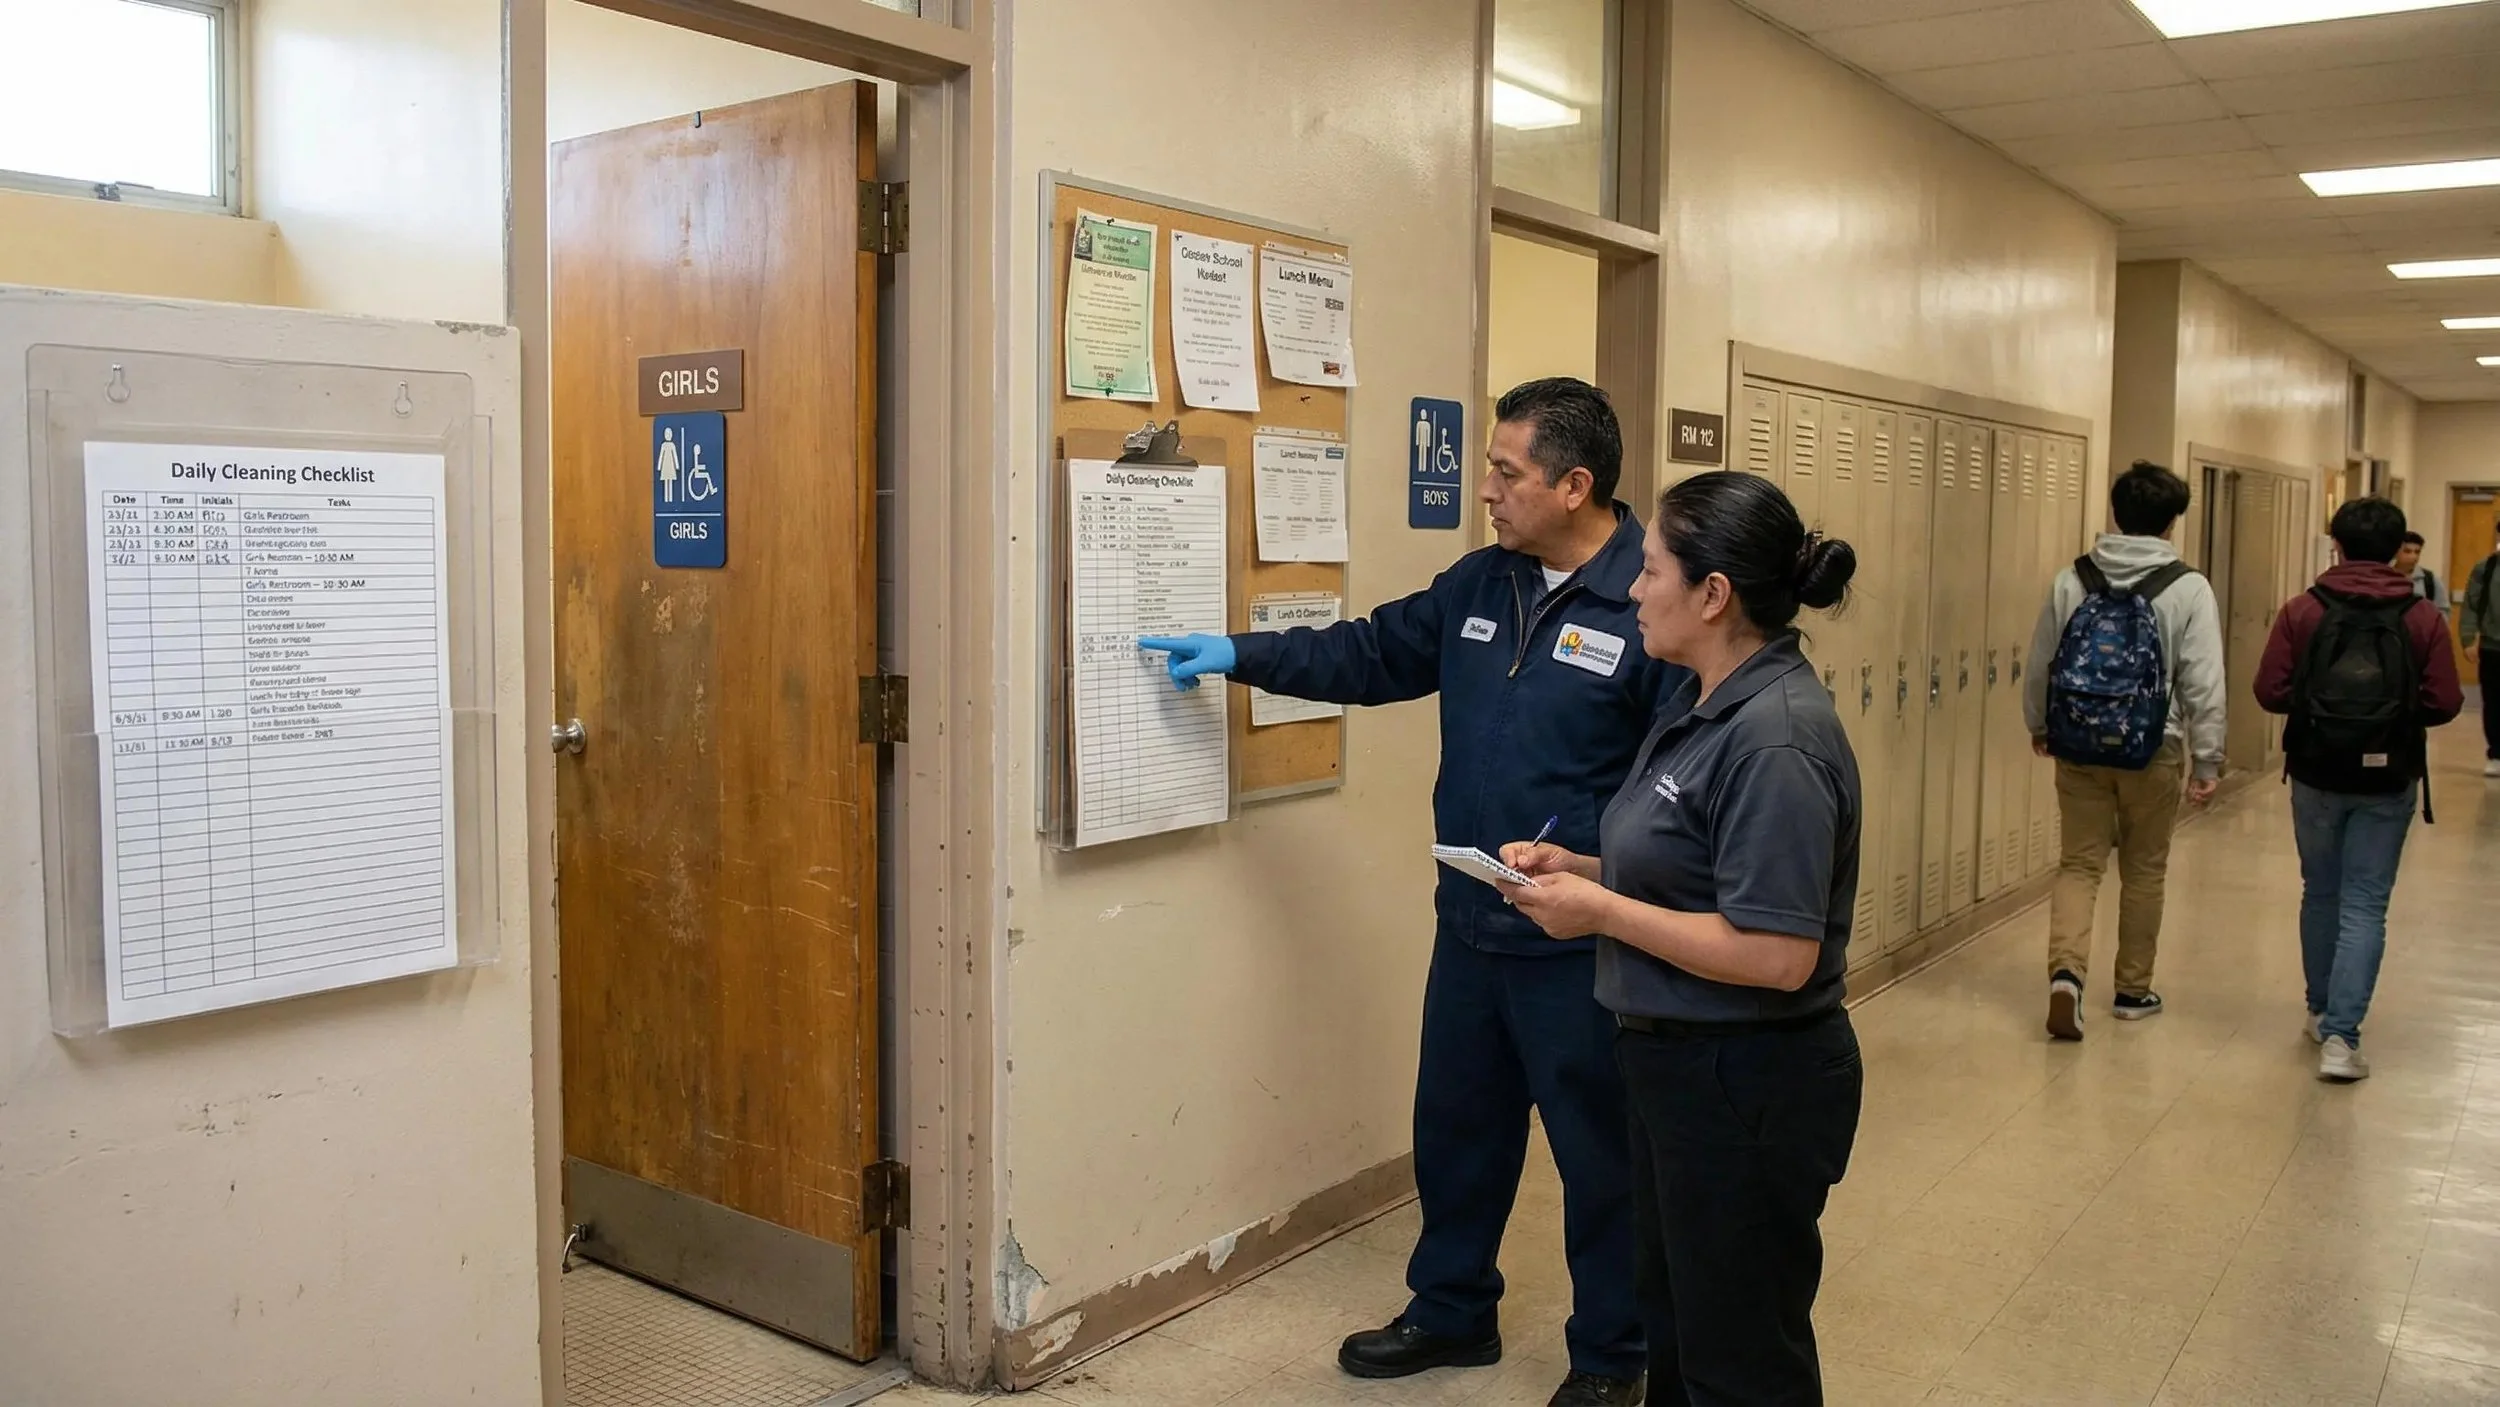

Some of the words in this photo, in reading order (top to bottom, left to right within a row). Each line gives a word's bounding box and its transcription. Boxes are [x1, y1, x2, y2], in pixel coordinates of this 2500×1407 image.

[1279, 266, 1306, 284] Lunch
[1309, 272, 1334, 288] Menu
[658, 366, 720, 397] GIRLS
[1681, 425, 1697, 445] RM
[1700, 428, 1714, 447] 112
[171, 462, 216, 482] Daily
[222, 463, 297, 484] Cleaning
[301, 466, 375, 483] Checklist
[113, 495, 137, 504] Date
[202, 496, 233, 505] Initials
[1423, 489, 1449, 506] BOYS
[669, 521, 708, 540] GIRLS
[339, 553, 354, 562] AM
